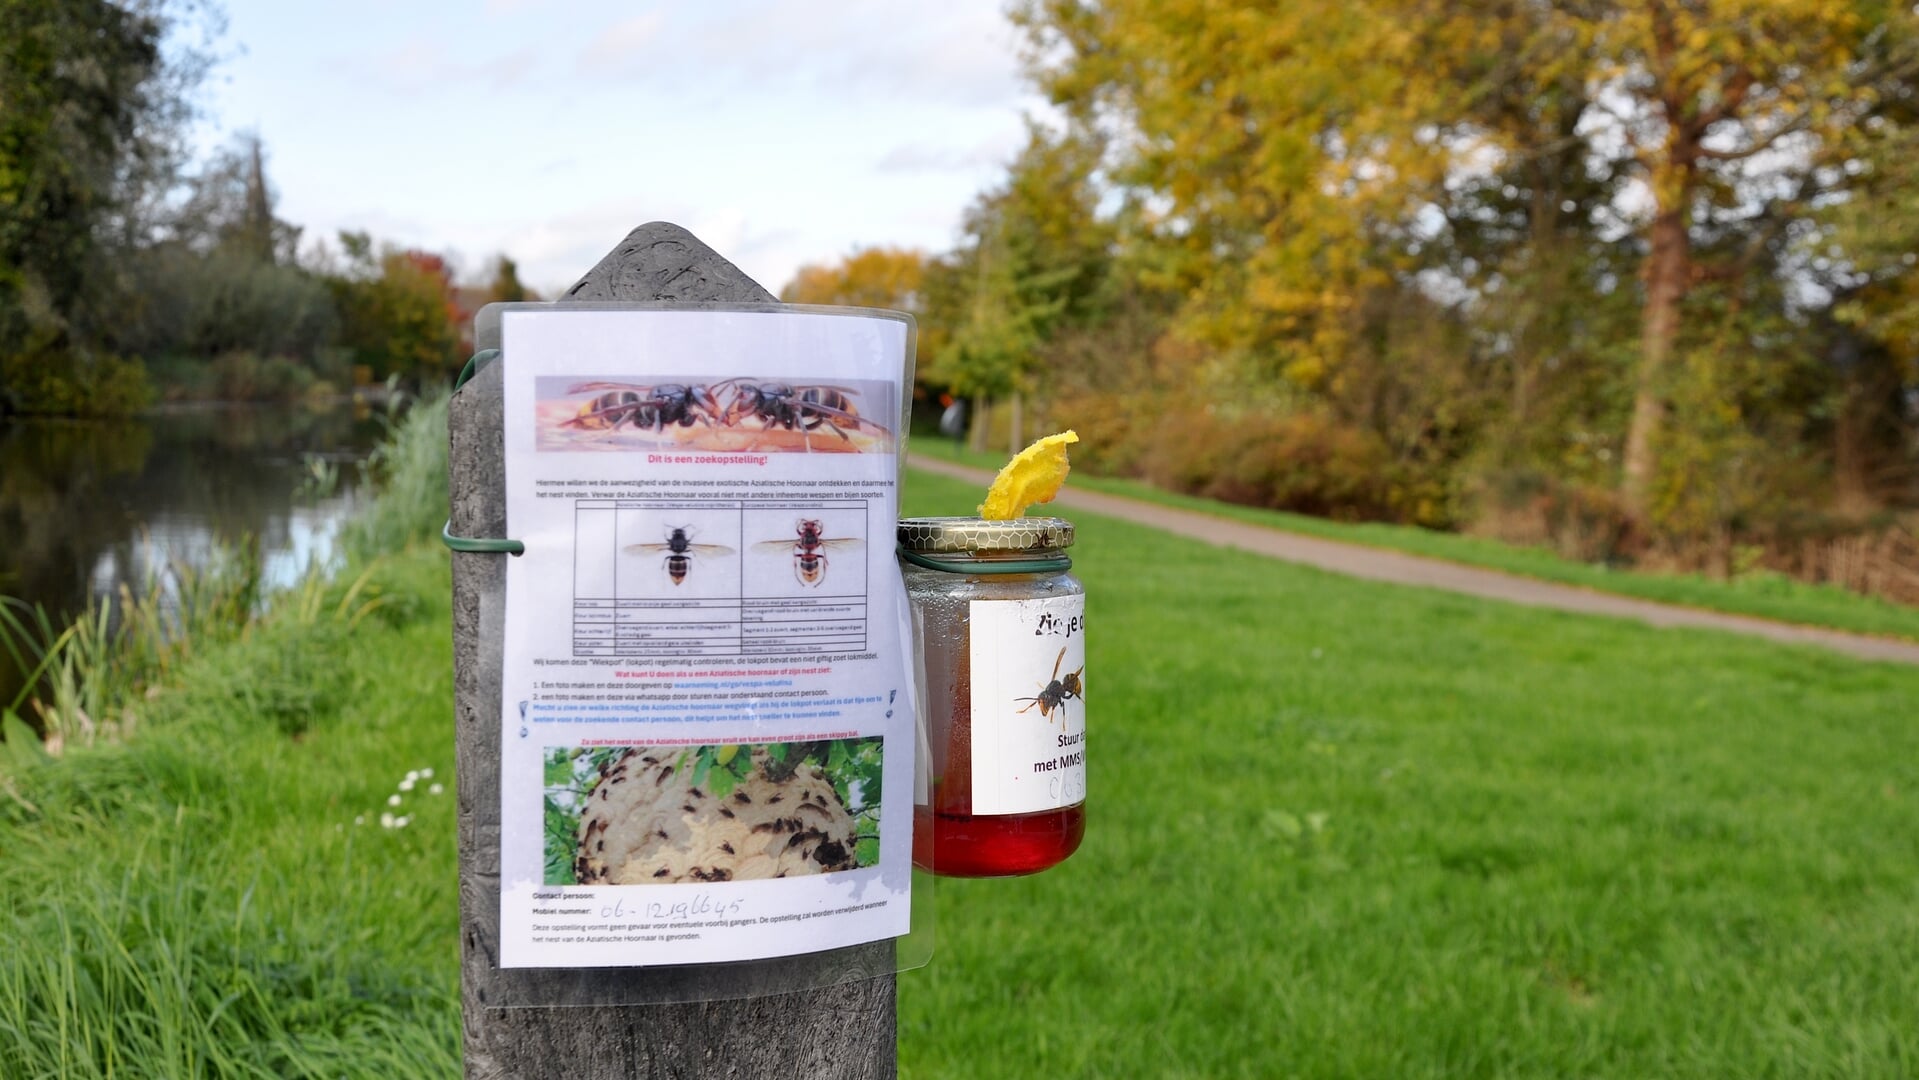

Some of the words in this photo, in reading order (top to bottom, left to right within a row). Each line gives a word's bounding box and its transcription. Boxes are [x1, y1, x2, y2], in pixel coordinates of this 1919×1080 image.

[647, 455, 662, 464] Dit
[663, 455, 672, 464] is
[694, 455, 769, 467] zoekopstelling!
[1066, 616, 1077, 638] je
[1058, 734, 1079, 747] Stuur
[1034, 758, 1057, 772] met
